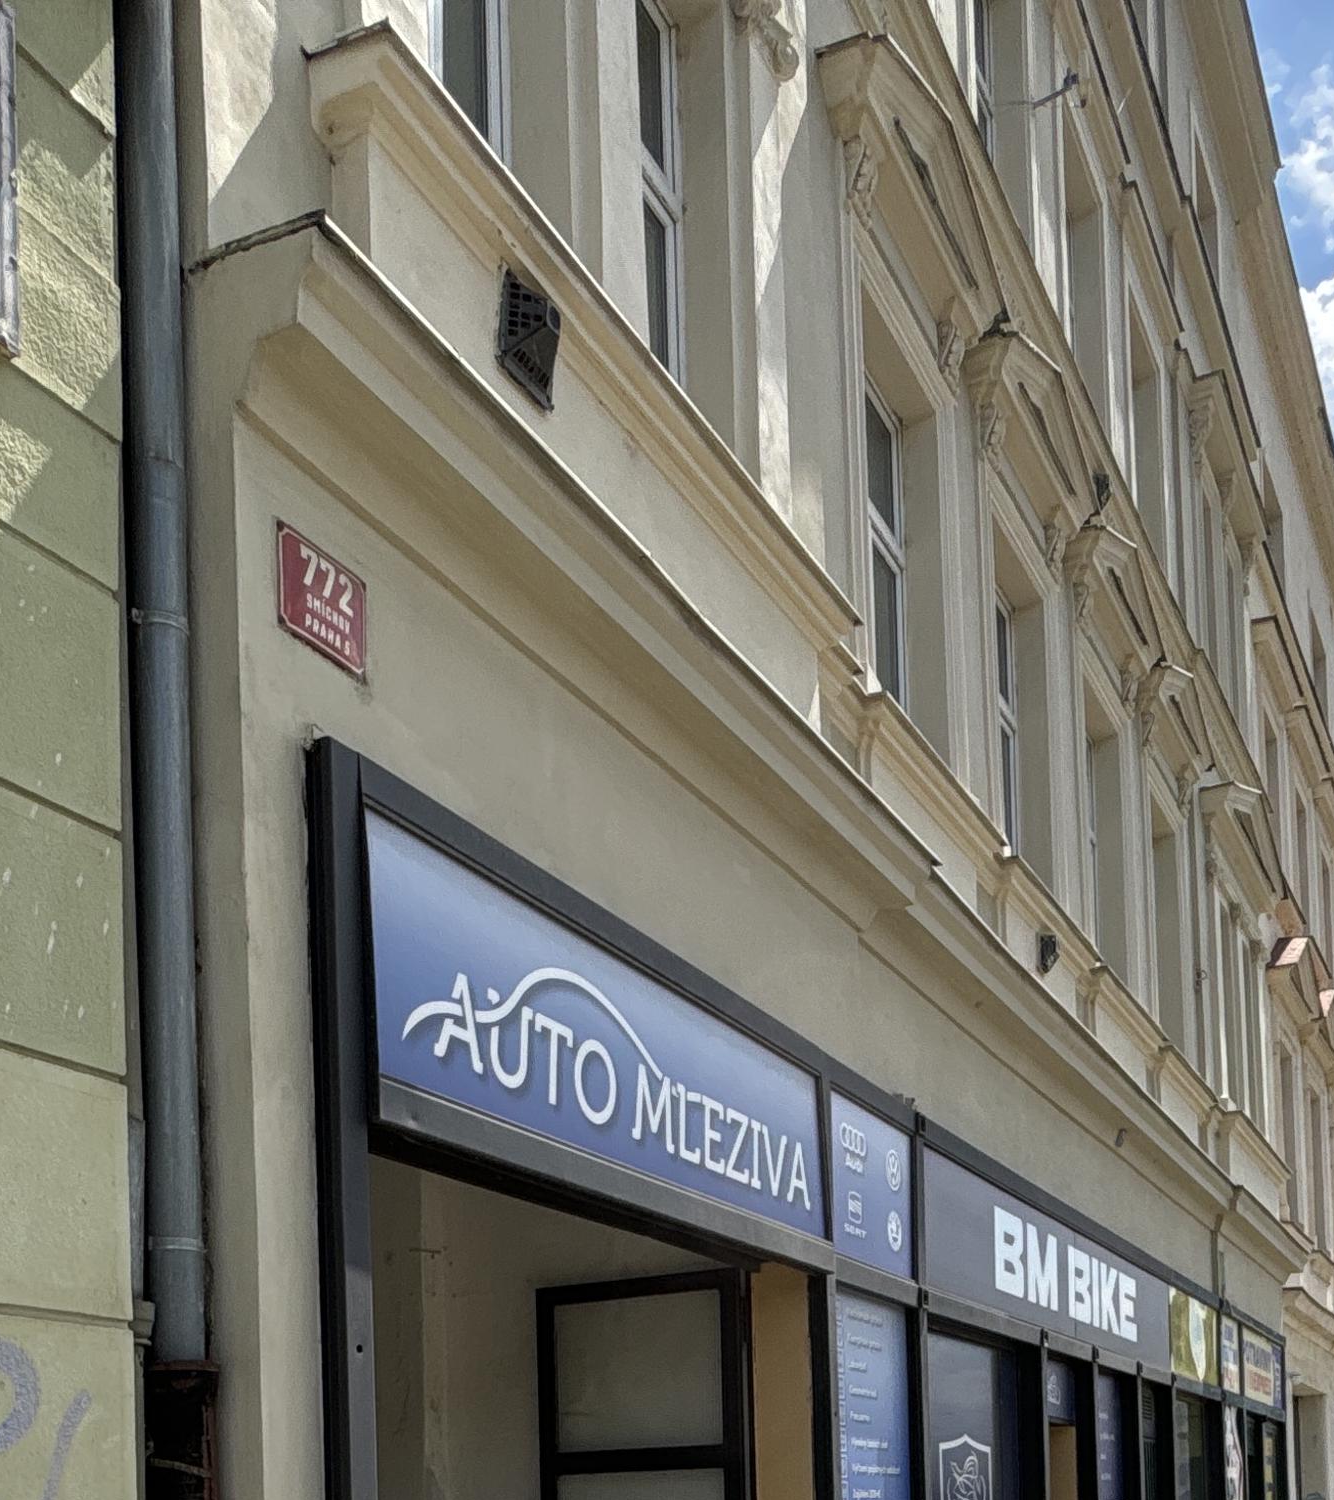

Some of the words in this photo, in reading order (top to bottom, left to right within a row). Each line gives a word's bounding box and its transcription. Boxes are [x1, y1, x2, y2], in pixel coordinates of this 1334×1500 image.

[299, 543, 354, 618] 772
[305, 613, 341, 648] PRAHA
[343, 640, 351, 656] 5
[307, 593, 351, 635] SMÍCHOV
[431, 972, 618, 1127] AUTO
[631, 1063, 812, 1211] MLEZIVA
[843, 1222, 868, 1239] SEAT
[993, 1204, 1059, 1312] BM
[1067, 1243, 1139, 1342] BIKE
